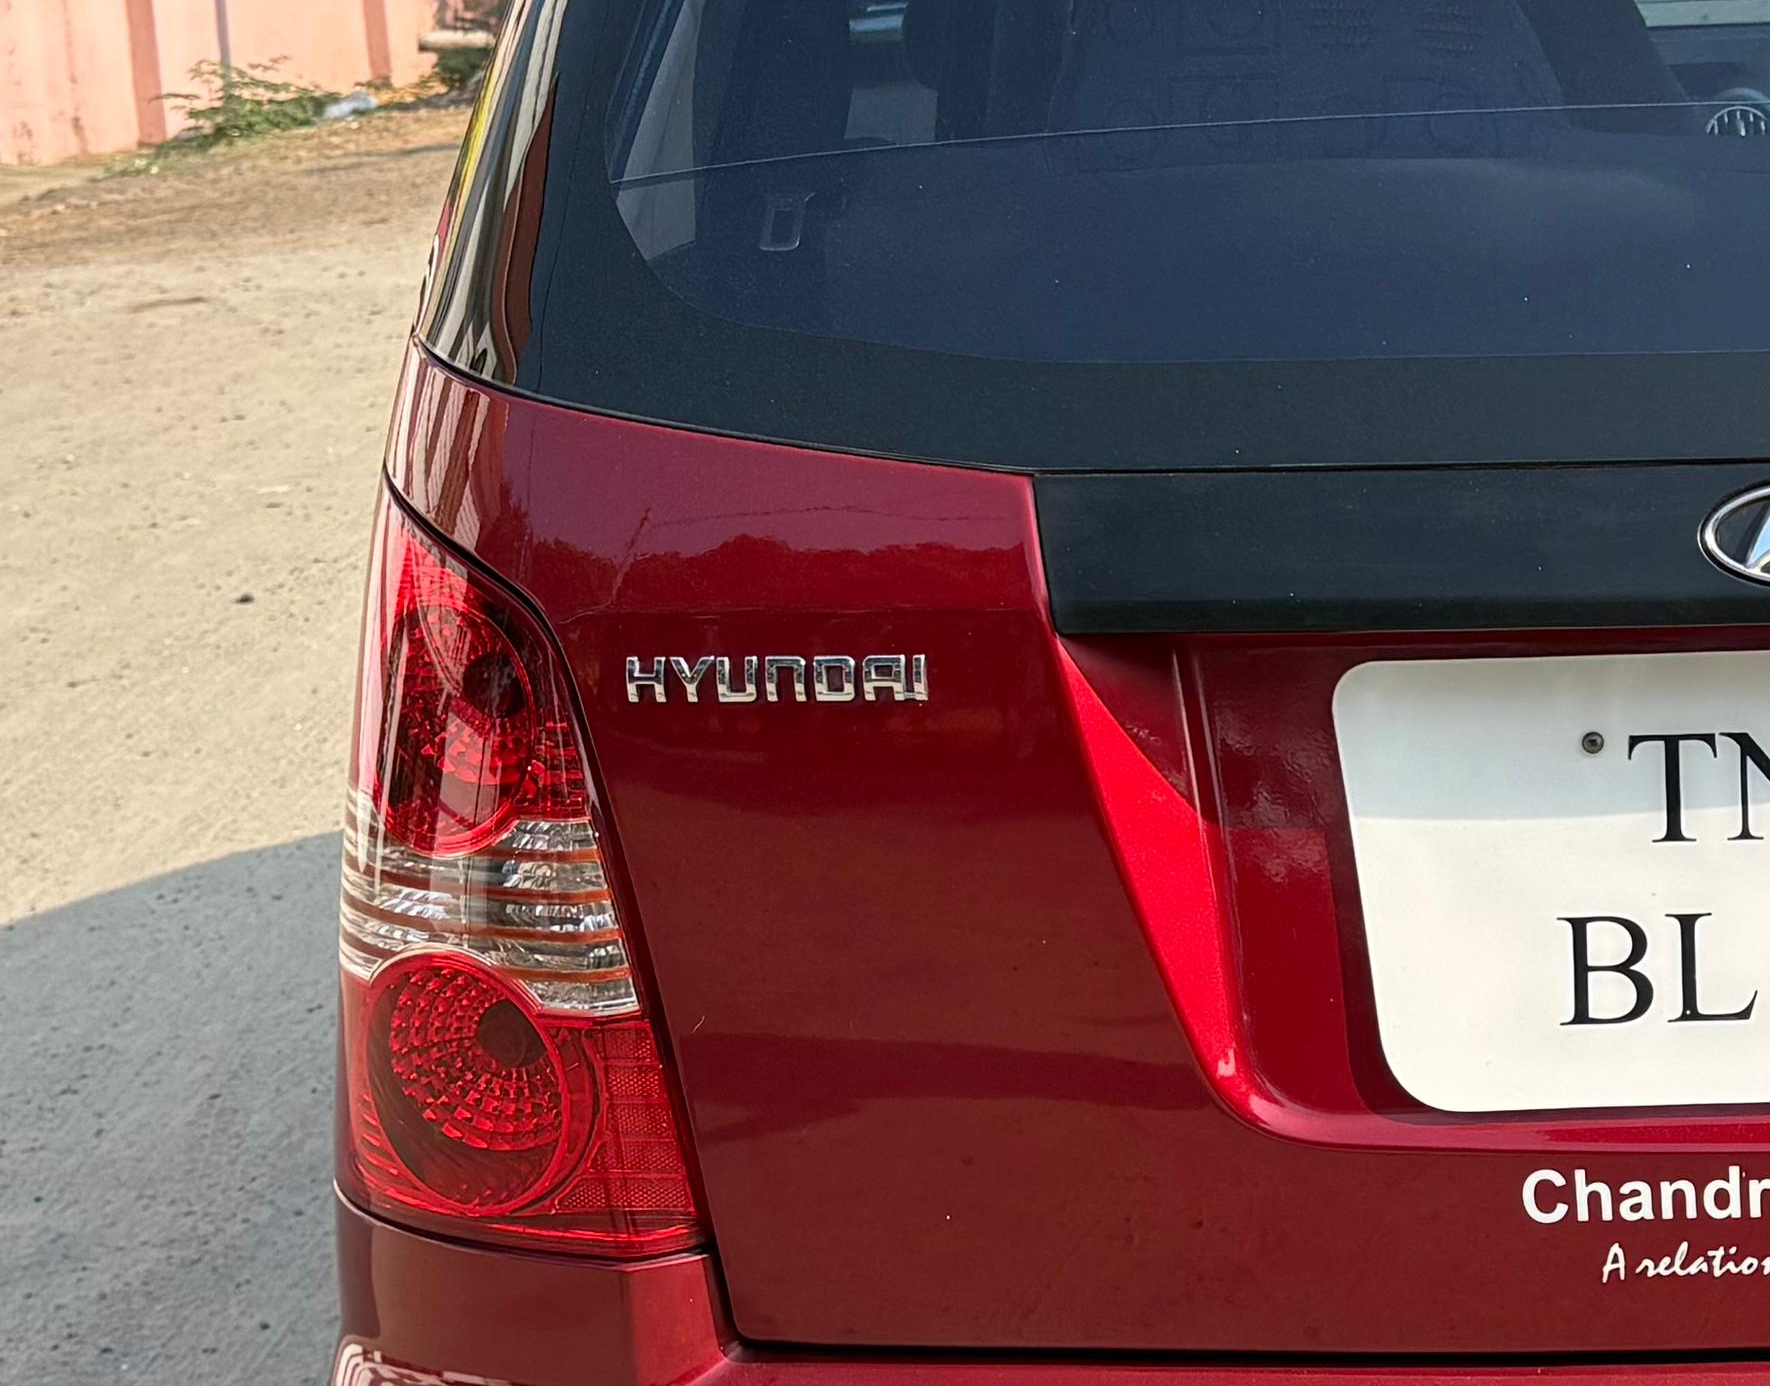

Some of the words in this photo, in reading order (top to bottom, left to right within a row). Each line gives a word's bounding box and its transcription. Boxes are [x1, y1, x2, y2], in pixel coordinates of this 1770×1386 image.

[625, 653, 929, 703] HYUNDAI
[1557, 912, 1758, 1027] BL
[1602, 1242, 1626, 1284] A
